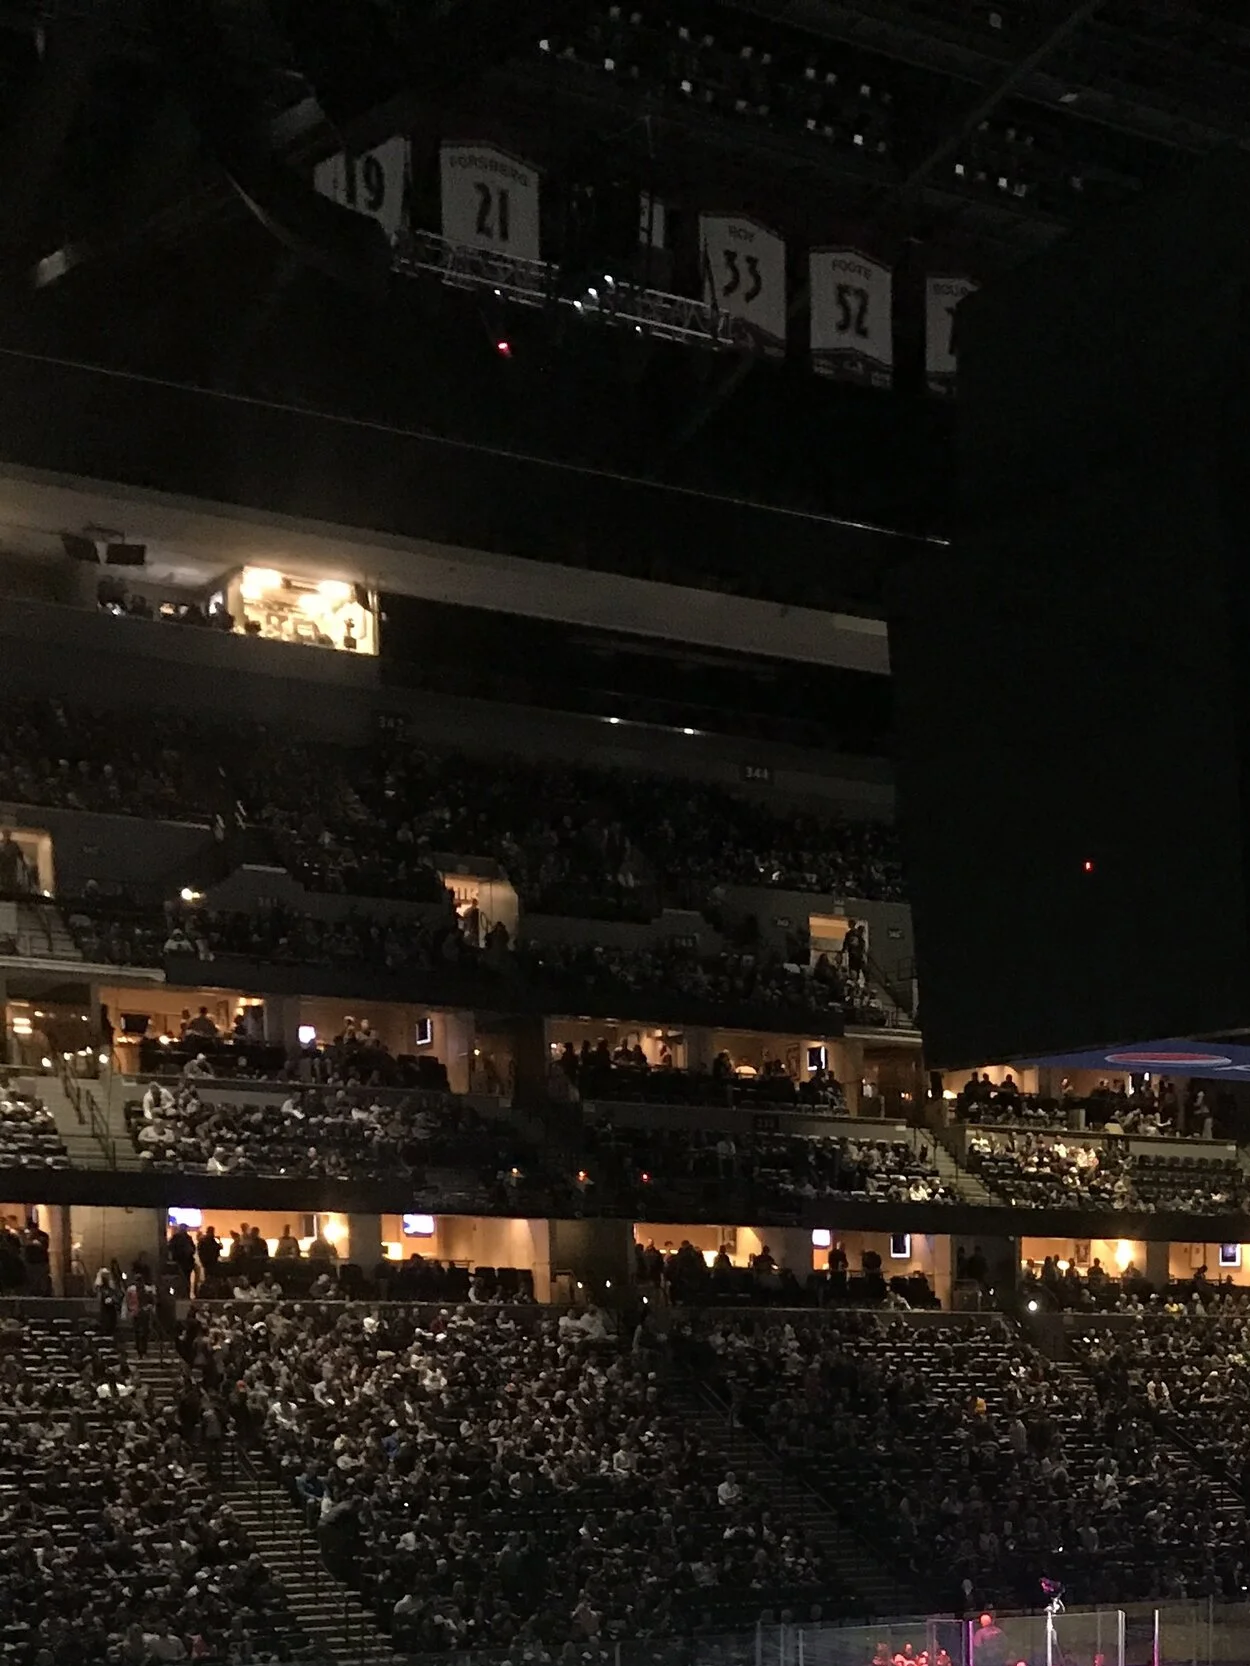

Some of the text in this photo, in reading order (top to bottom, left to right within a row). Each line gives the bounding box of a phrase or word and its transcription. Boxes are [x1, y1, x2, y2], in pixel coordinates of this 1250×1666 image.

[449, 154, 530, 188] FORSBERG
[473, 181, 510, 242] 21
[722, 249, 762, 303] 33
[832, 259, 873, 278] FOOTE
[836, 283, 869, 337] 52
